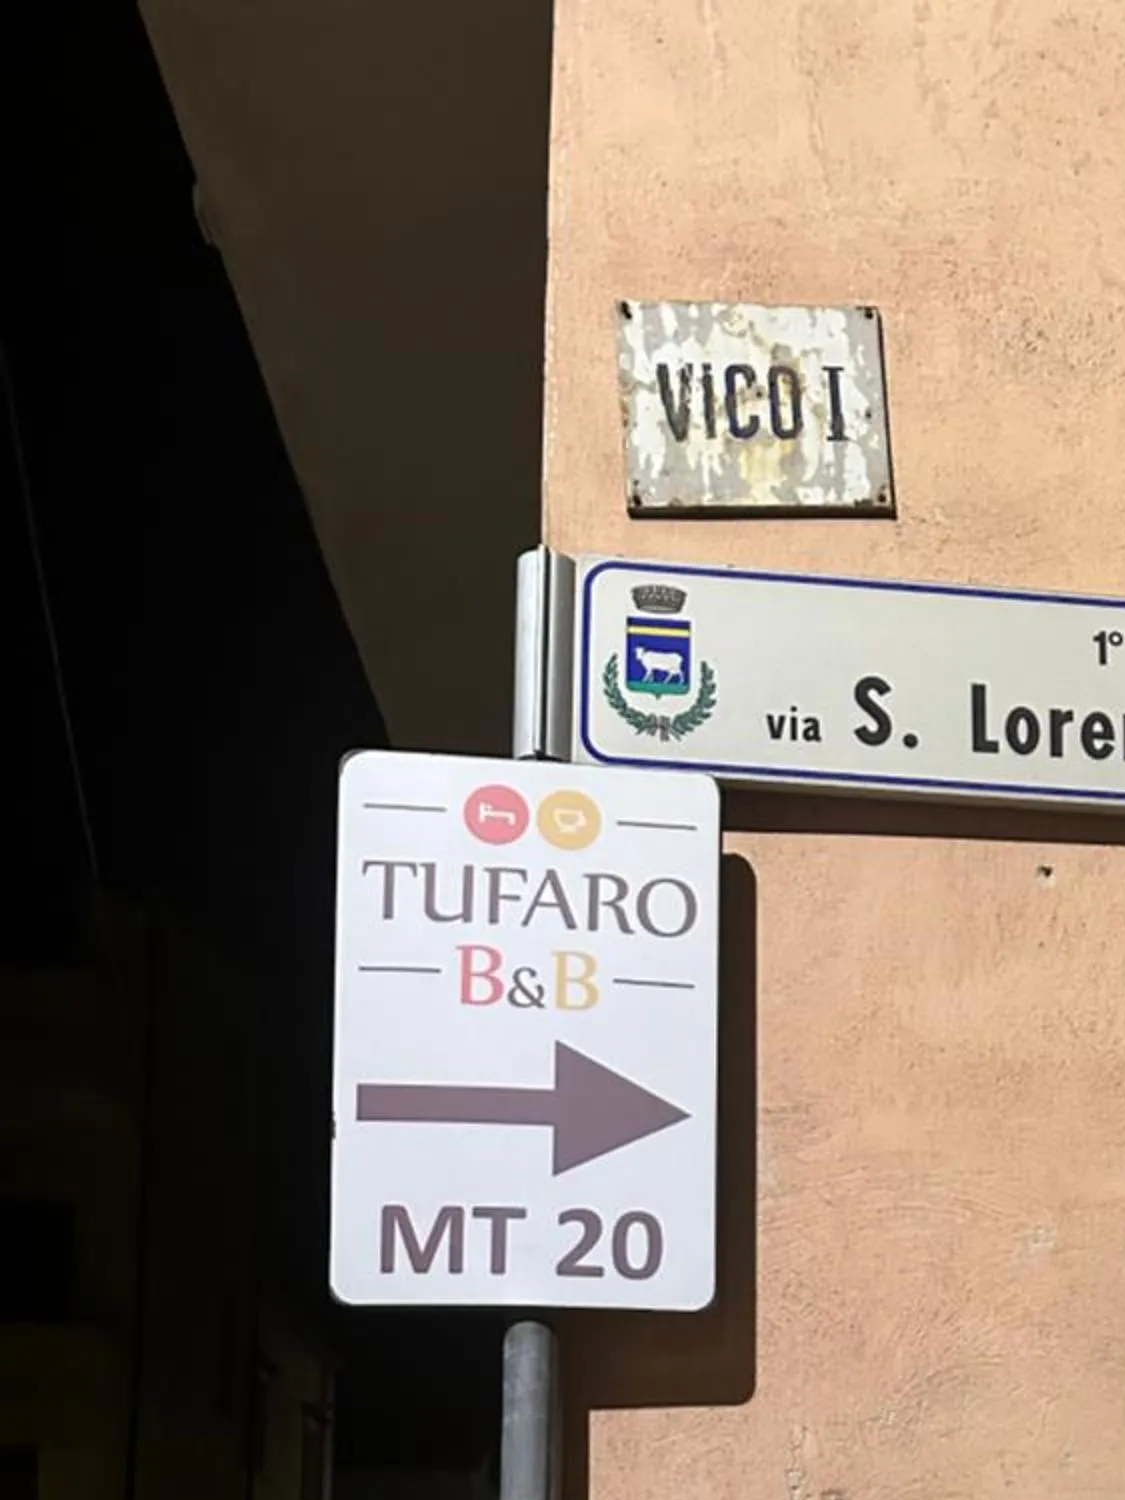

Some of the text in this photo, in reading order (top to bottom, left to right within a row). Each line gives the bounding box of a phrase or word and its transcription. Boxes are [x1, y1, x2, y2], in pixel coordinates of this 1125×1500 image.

[822, 365, 849, 441] I
[766, 706, 822, 742] via
[853, 676, 920, 749] S.
[362, 860, 698, 937] TUFARO
[455, 944, 600, 1012] B&B
[379, 1204, 664, 1280] MT 20
